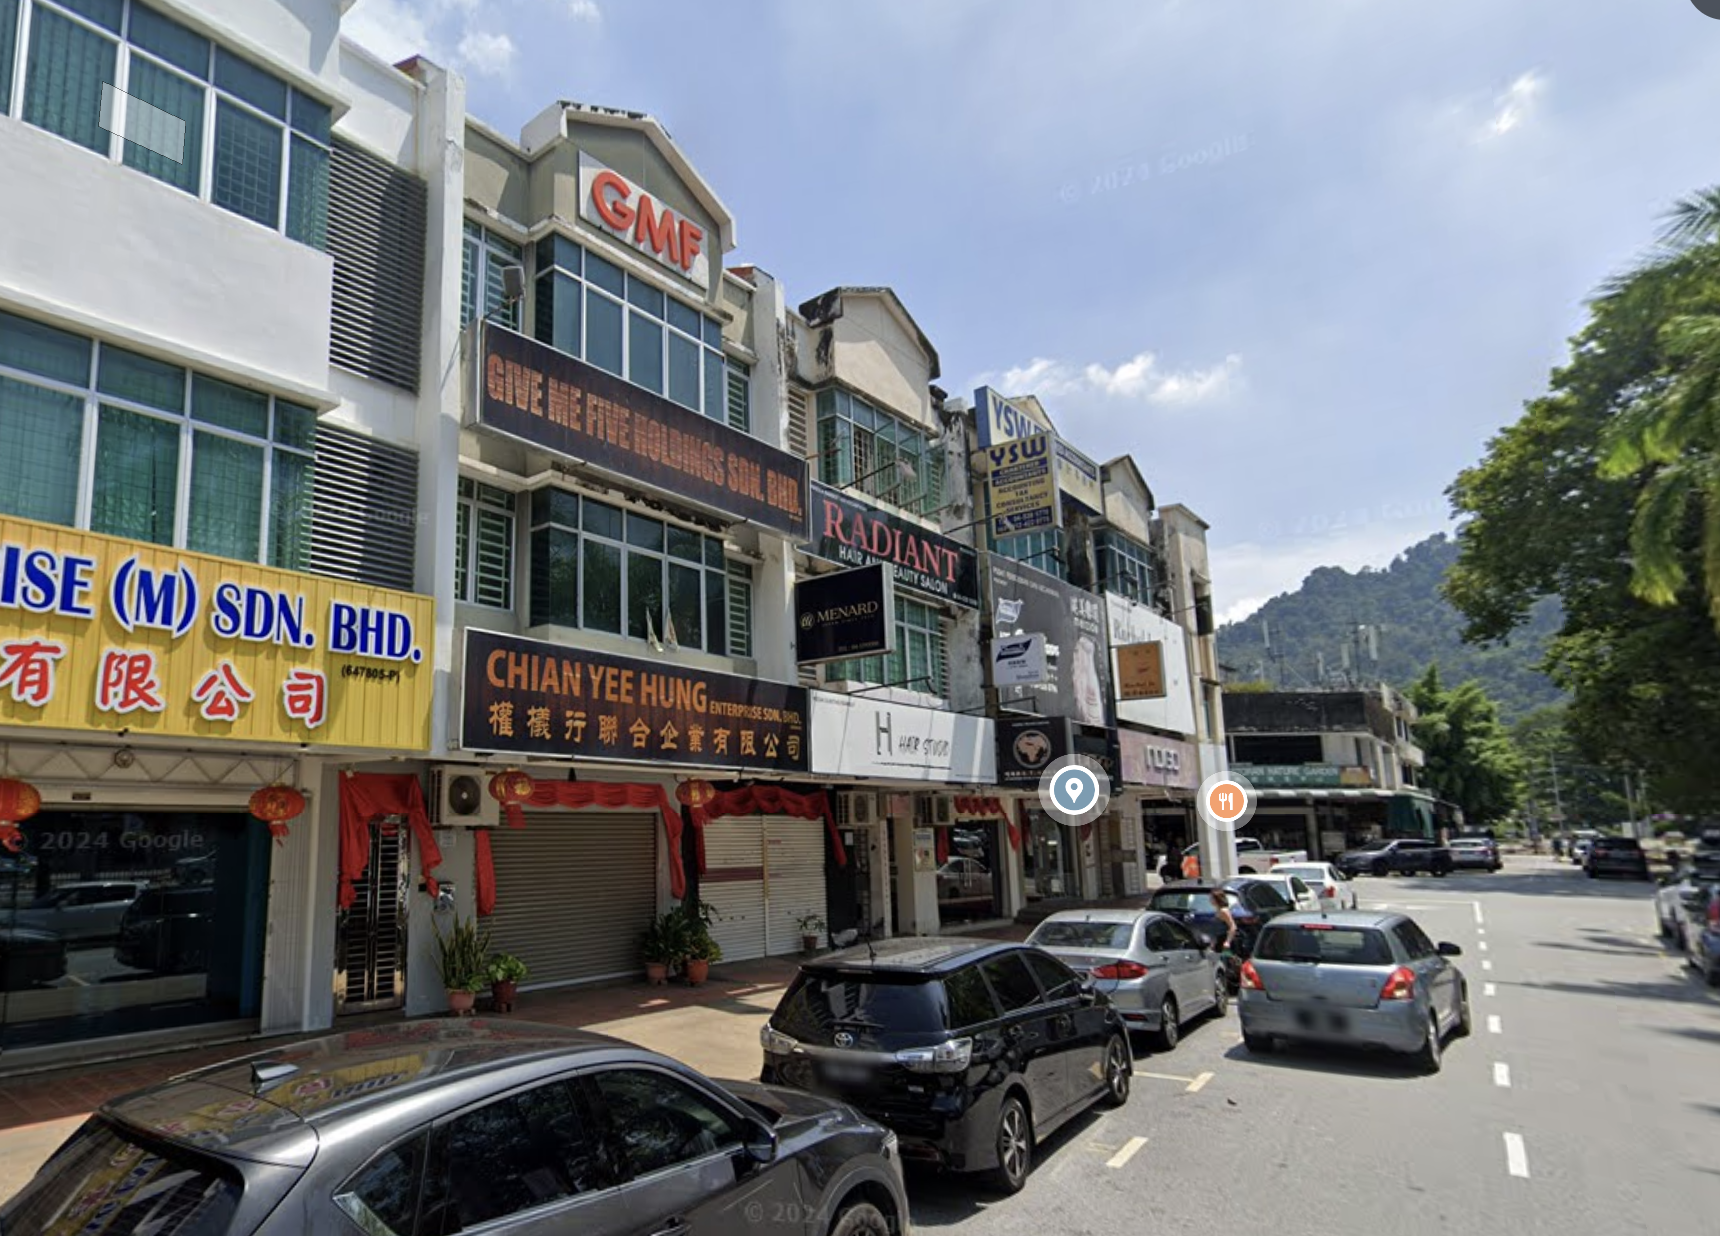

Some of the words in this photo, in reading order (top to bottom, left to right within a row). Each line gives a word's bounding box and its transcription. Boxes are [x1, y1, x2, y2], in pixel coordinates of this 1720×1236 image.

[592, 171, 702, 271] GMF
[487, 352, 543, 418] GIVE
[548, 377, 581, 431] ME
[586, 392, 630, 450] FIVE
[634, 412, 725, 486] HOLDINGS
[727, 452, 765, 502] SDN.
[767, 469, 802, 516] BHD.
[990, 436, 1046, 467] YSW
[992, 395, 1031, 439] YSW
[823, 500, 957, 582] RADIANT
[839, 545, 863, 566] HAIR
[894, 565, 918, 586] EAUTY
[920, 574, 948, 595] SALON
[0, 546, 94, 616] ISE
[113, 556, 197, 633] (M)
[213, 583, 315, 646] SDN.
[331, 603, 422, 661] BHD.
[816, 600, 880, 623] MENARD
[0, 641, 325, 725] 有限公司
[486, 649, 581, 698] CHIAN
[586, 662, 635, 705] YEE
[640, 671, 707, 714] HUNG
[709, 701, 762, 719] ENTERPRISE
